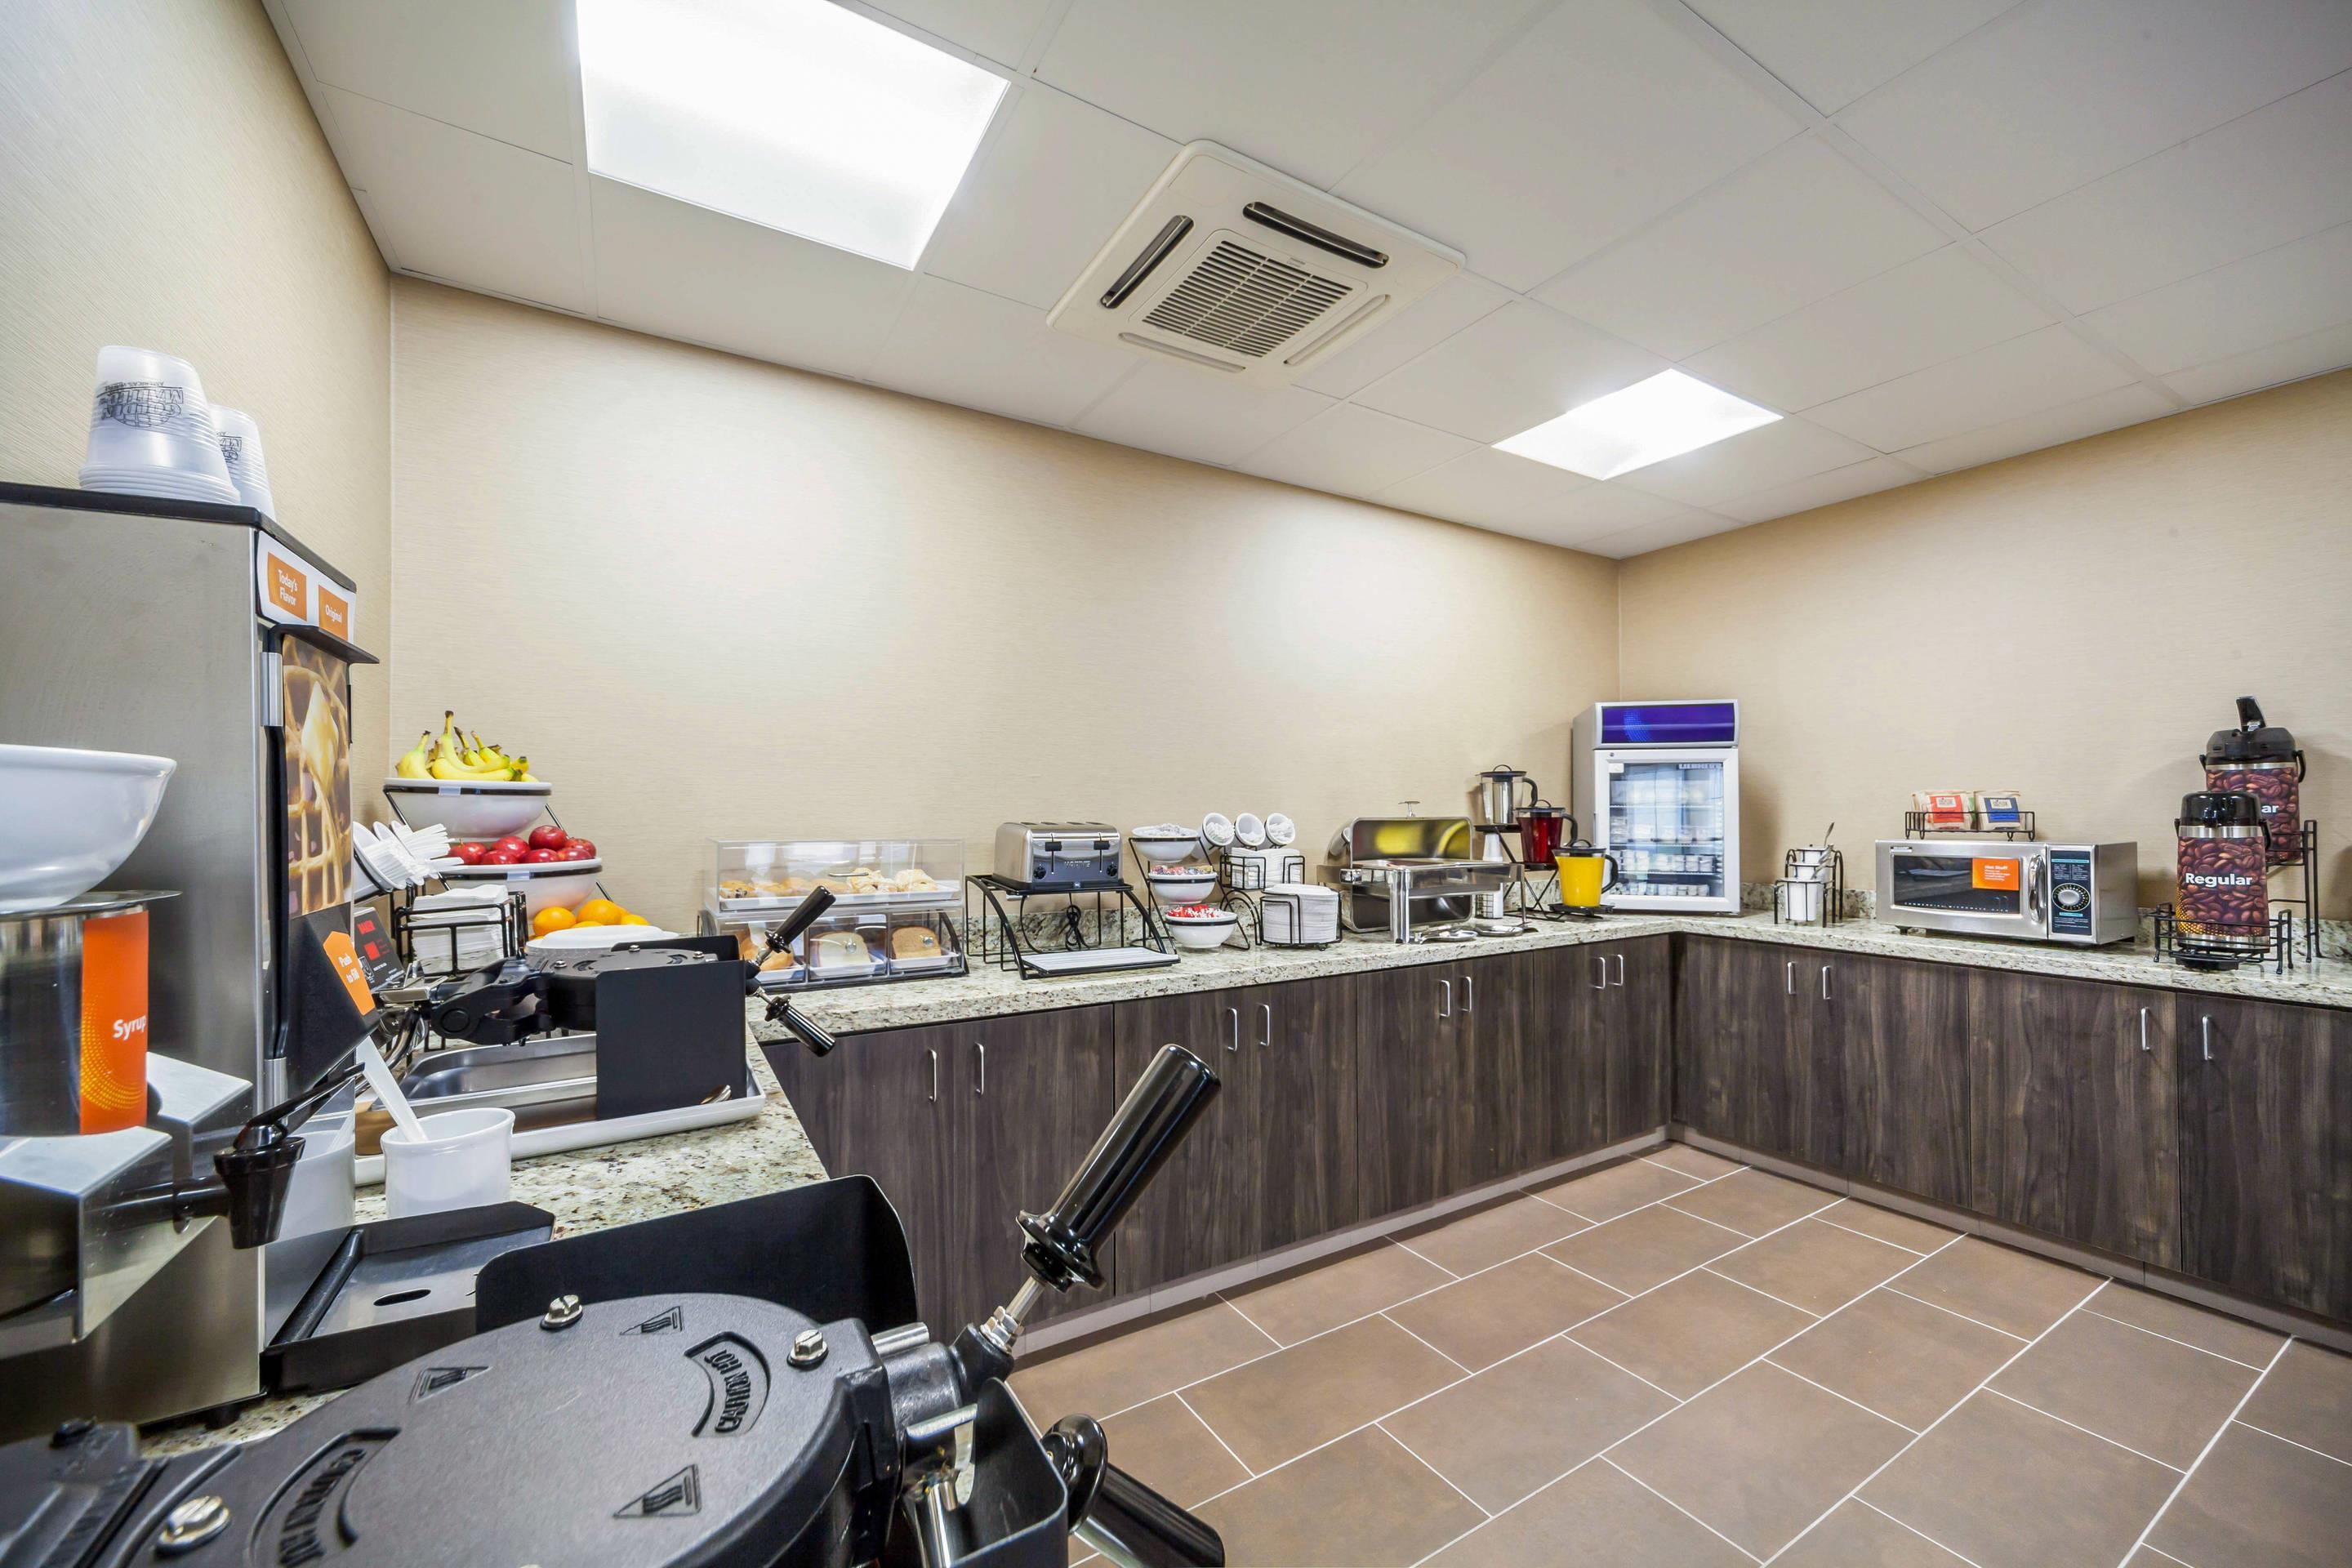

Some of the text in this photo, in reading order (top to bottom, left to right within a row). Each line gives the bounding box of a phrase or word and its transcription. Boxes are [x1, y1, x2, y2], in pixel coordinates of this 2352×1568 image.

[278, 568, 298, 592] Today's
[279, 586, 296, 606] Flavor
[325, 604, 342, 623] Original
[2185, 873, 2253, 888] Regular
[113, 1015, 146, 1041] Syrup
[703, 1348, 751, 1433] CAUTION HOT
